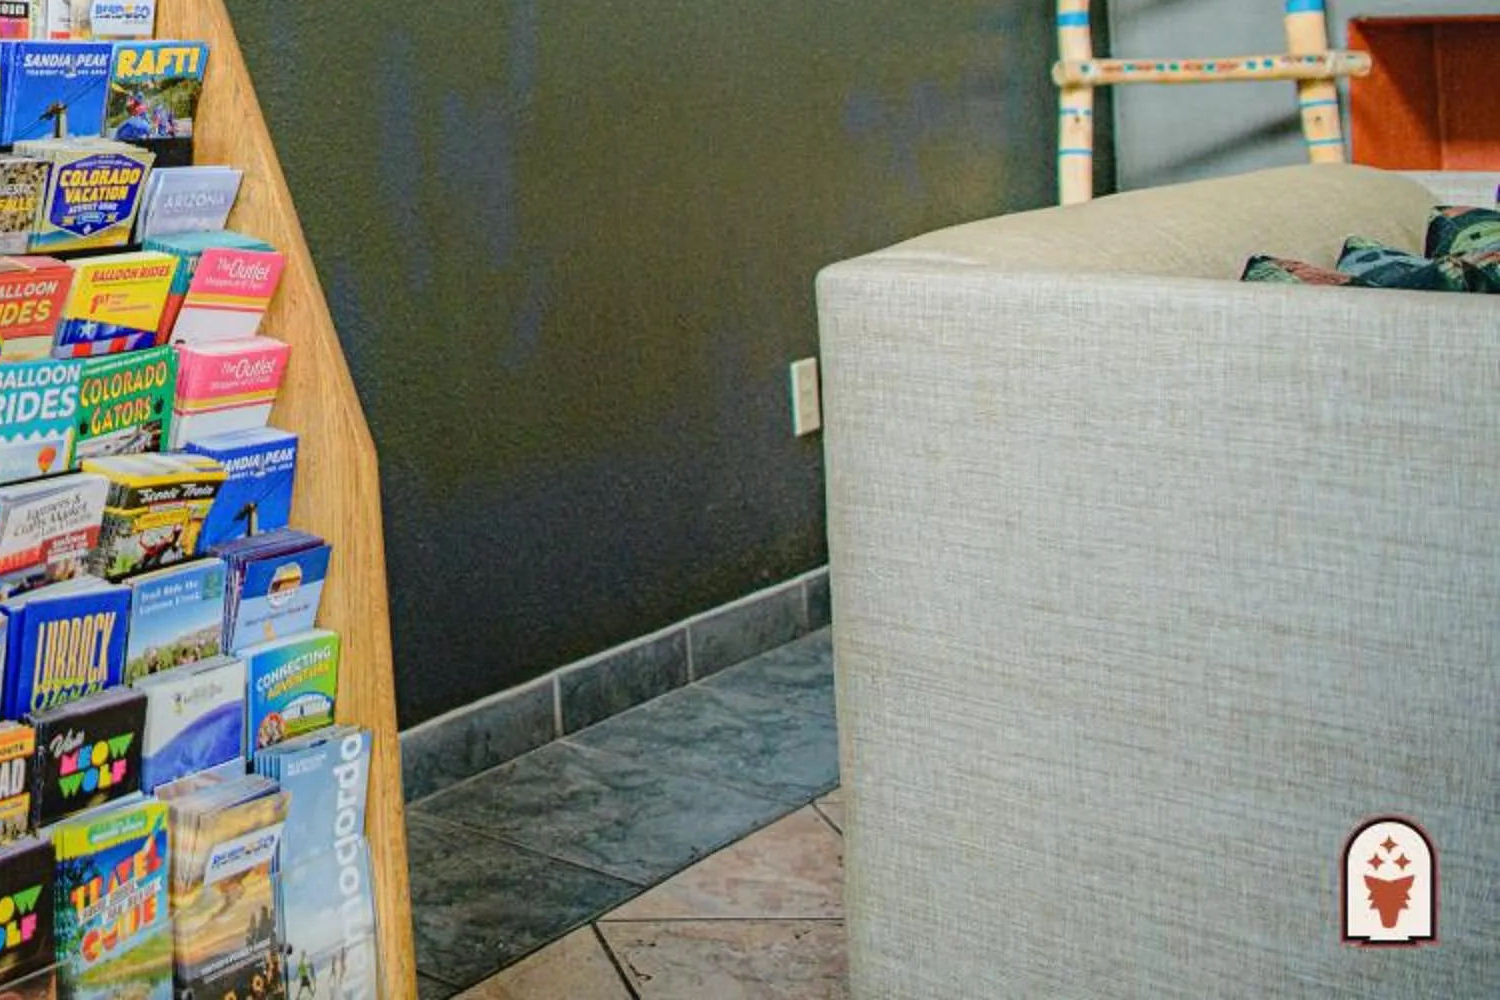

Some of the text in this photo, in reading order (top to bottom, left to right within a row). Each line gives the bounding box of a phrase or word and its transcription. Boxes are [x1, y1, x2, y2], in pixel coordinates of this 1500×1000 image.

[23, 53, 109, 68] SANDIA PEAK
[116, 46, 201, 78] RAFT!
[60, 168, 141, 187] COLORADO
[66, 185, 128, 203] VACATION
[79, 361, 167, 406] COLORADO
[90, 396, 151, 435] GATORS
[222, 448, 295, 473] ANDIA PEAK
[32, 611, 117, 691] LUBBOCK
[255, 642, 333, 694] CONNECTING
[59, 732, 135, 776] MEOW
[58, 758, 127, 799] WOLF
